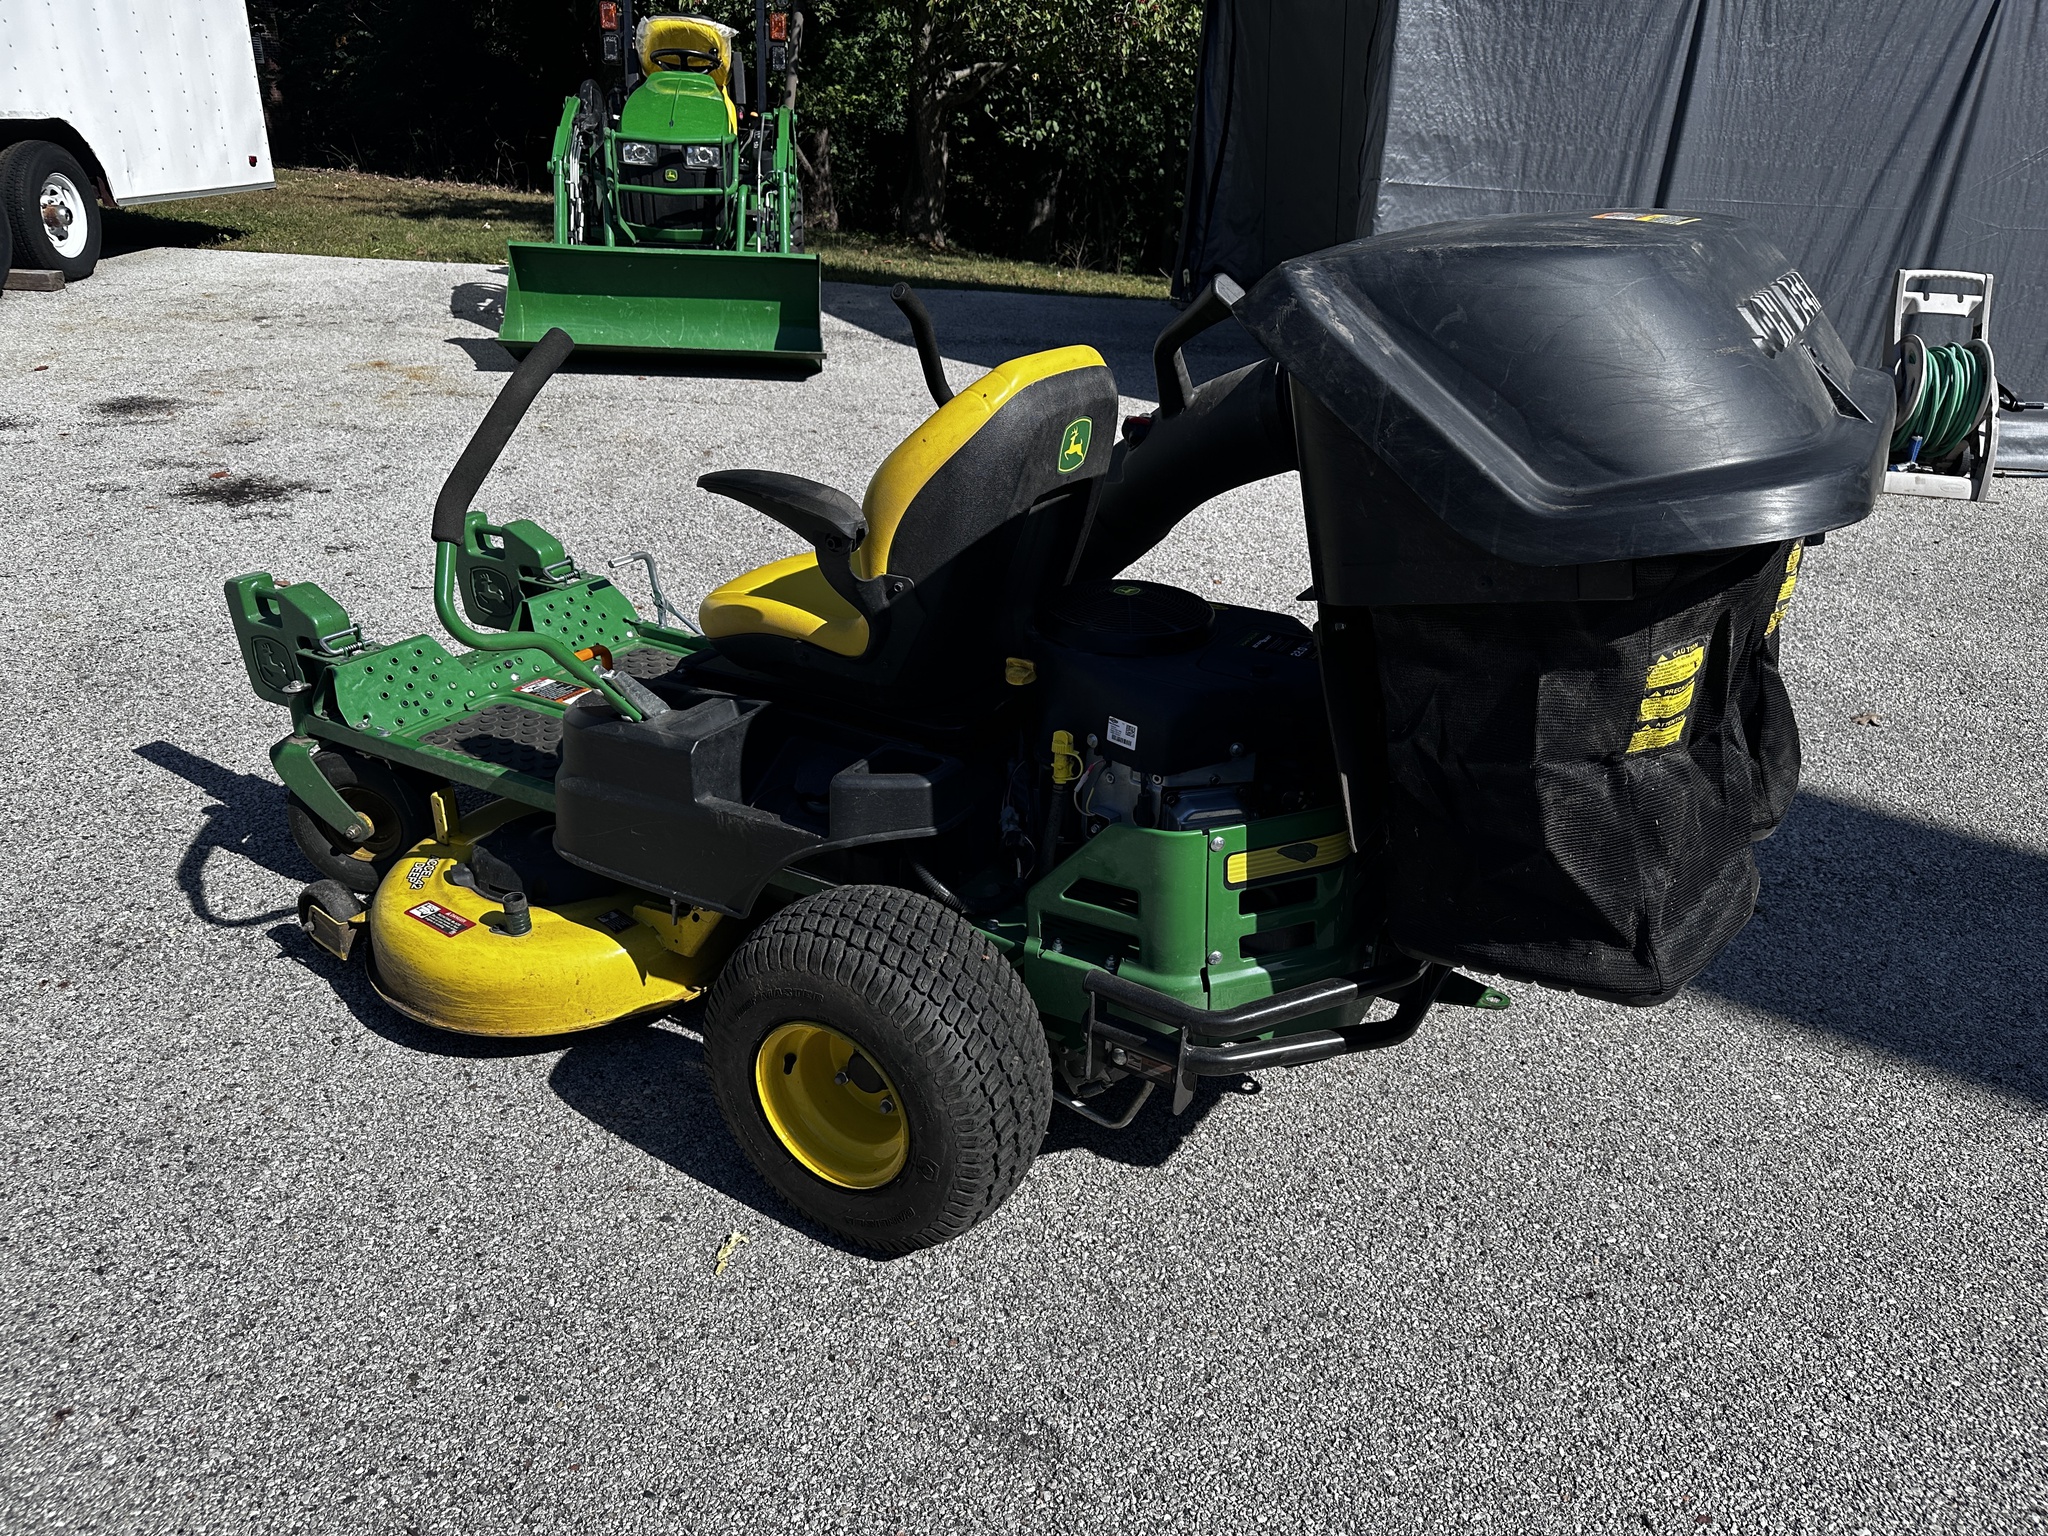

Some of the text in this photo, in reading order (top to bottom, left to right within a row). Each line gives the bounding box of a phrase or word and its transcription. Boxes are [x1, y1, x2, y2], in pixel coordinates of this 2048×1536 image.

[1672, 642, 1699, 657] CAUTION
[407, 862, 425, 885] DEEP
[760, 986, 825, 1003] MASTER
